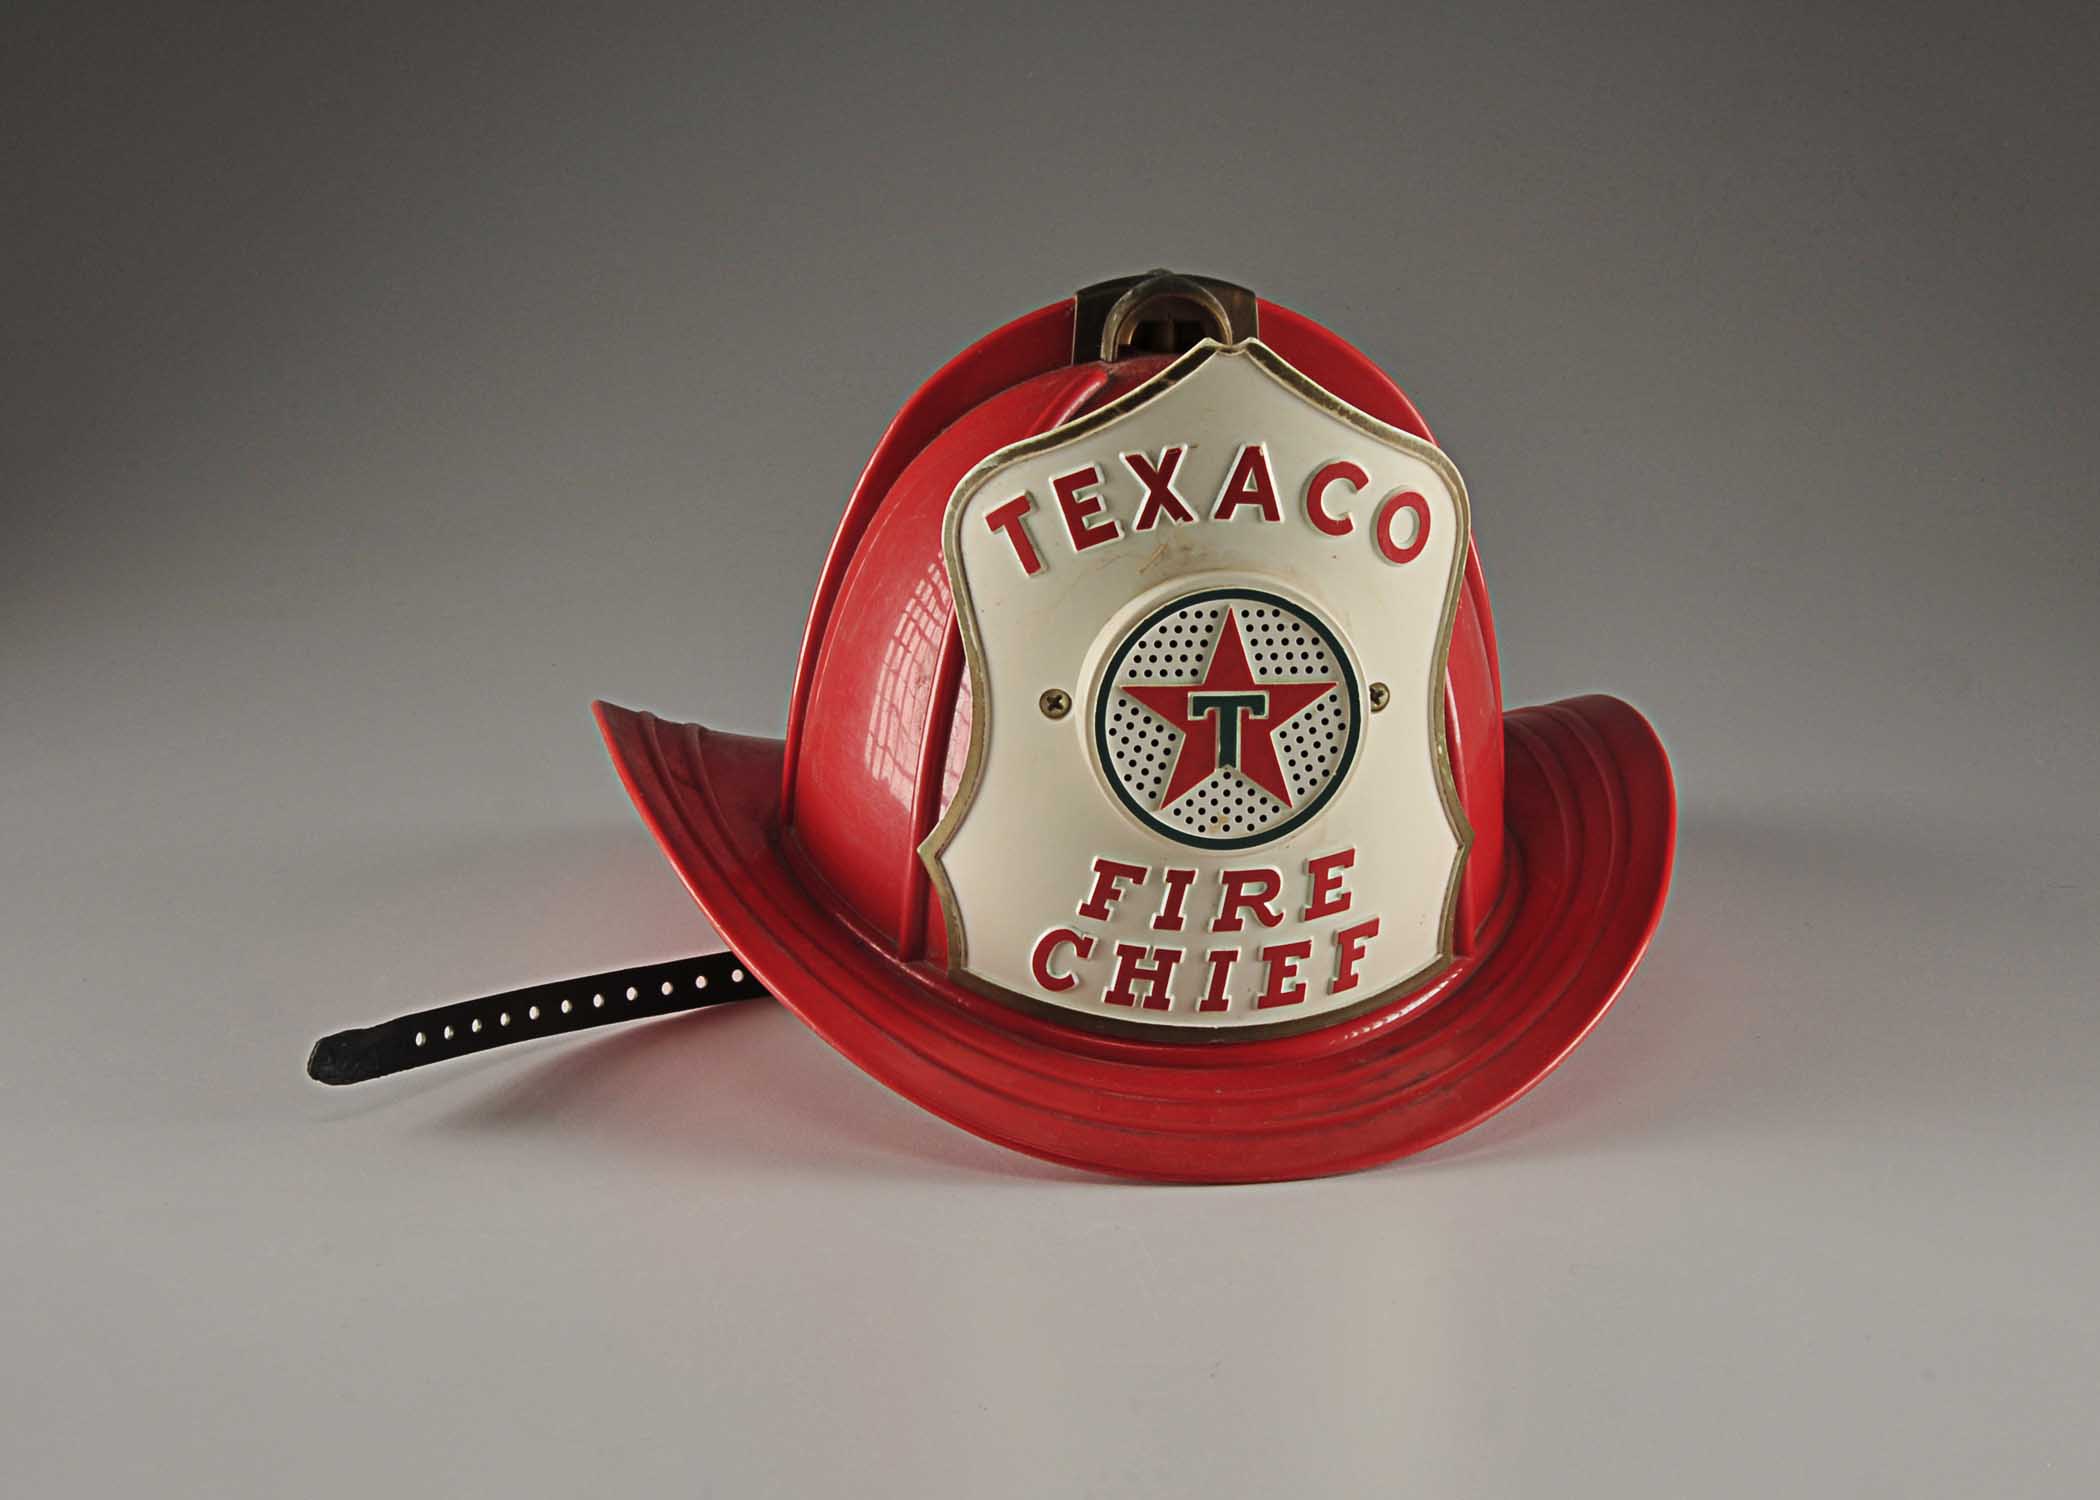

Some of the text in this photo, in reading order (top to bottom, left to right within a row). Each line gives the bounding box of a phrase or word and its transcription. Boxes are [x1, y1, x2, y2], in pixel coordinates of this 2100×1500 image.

[985, 445, 1432, 576] TEXACO
[1187, 691, 1268, 769] T
[1078, 848, 1356, 933] FIRE
[1031, 918, 1380, 1013] CHIEF
